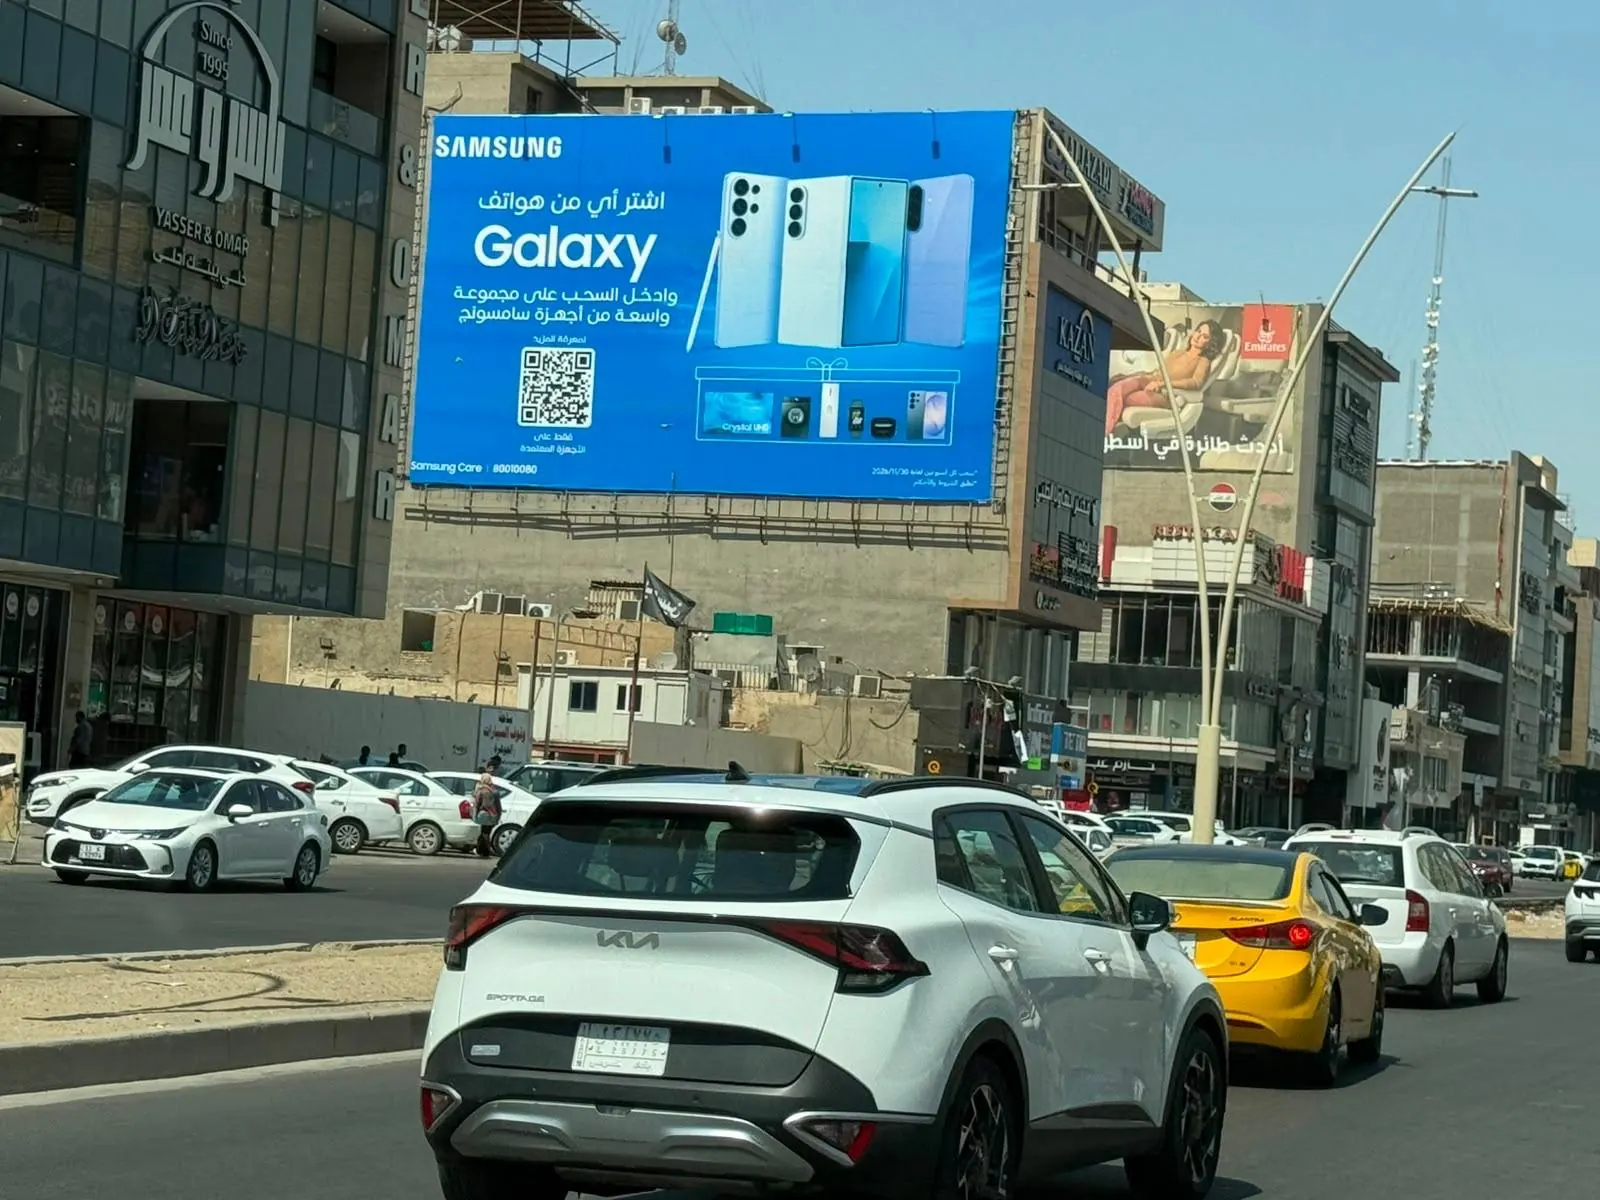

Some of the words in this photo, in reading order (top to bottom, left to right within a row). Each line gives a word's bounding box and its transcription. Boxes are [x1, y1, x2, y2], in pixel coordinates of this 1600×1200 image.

[201, 20, 234, 50] Since
[202, 53, 230, 81] 1995
[435, 135, 562, 159] SAMSUNG
[400, 143, 417, 189] &
[478, 190, 545, 216] هواتف
[550, 193, 581, 214] من
[587, 188, 617, 219] أي
[616, 190, 666, 217] اشتر
[155, 206, 202, 242] YASSER
[203, 226, 213, 246] &
[215, 230, 250, 257] OMAR
[474, 224, 658, 284] Galaxy
[453, 285, 520, 304] مجموعة
[523, 287, 558, 304] على
[561, 286, 619, 305] السحب
[623, 287, 679, 307] وادخل
[458, 305, 531, 324] سامسونج
[534, 304, 583, 325] أجهزة
[587, 309, 610, 325] من
[614, 307, 670, 327] واسعة
[1060, 315, 1097, 365] KAZAN
[1244, 341, 1287, 353] Emirates
[721, 422, 752, 433] Crystal
[1153, 435, 1180, 460] في
[410, 461, 457, 475] Samsung
[458, 462, 483, 473] Care
[492, 463, 538, 475] 80010080
[596, 930, 660, 950] KIA
[486, 993, 545, 1003] SPORTAGE
